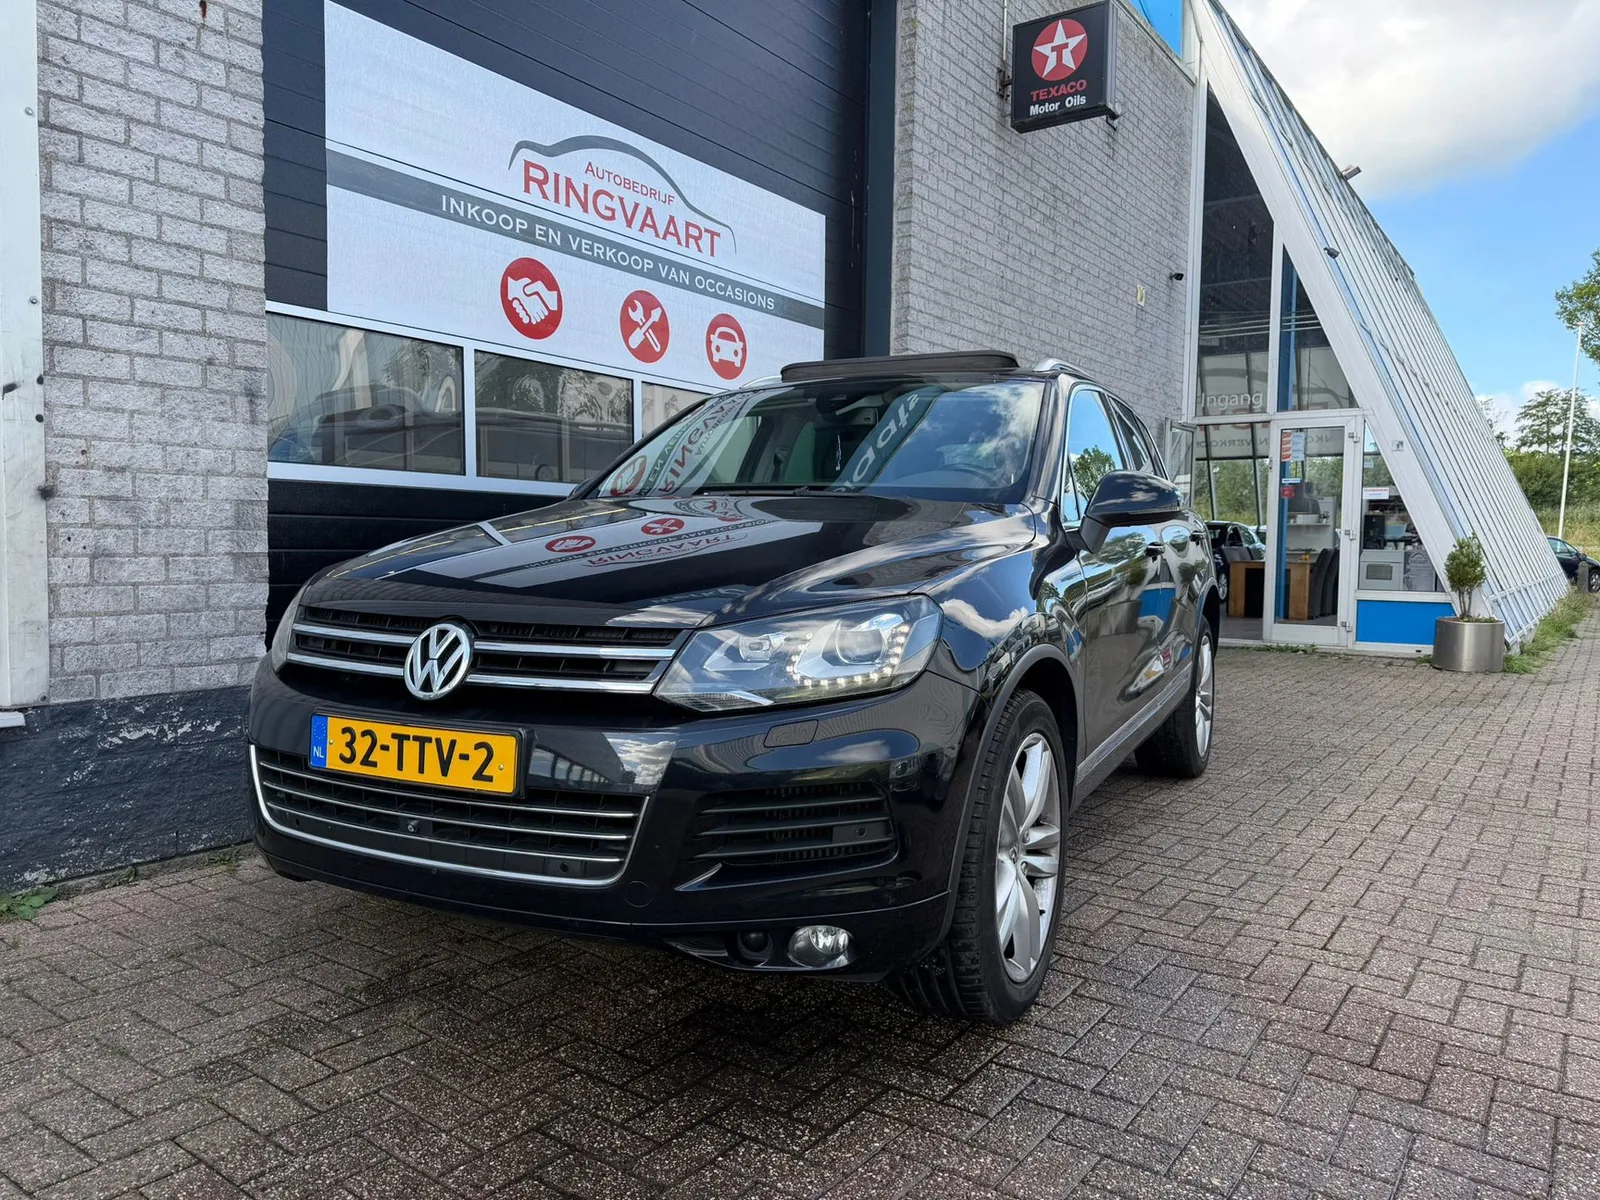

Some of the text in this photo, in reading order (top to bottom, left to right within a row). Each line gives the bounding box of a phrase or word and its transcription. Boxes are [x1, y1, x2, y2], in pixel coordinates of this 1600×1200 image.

[1029, 95, 1087, 117] Motor Oils
[1030, 79, 1087, 102] TEXACO
[584, 161, 675, 206] AUTOBEDRIJF
[523, 159, 721, 258] RINGVAART
[441, 194, 776, 311] INKOOP EN VERKOOP VAN OCCASIONS
[1201, 392, 1263, 410] Ingang
[313, 726, 494, 783] NL 32-TTV-2
